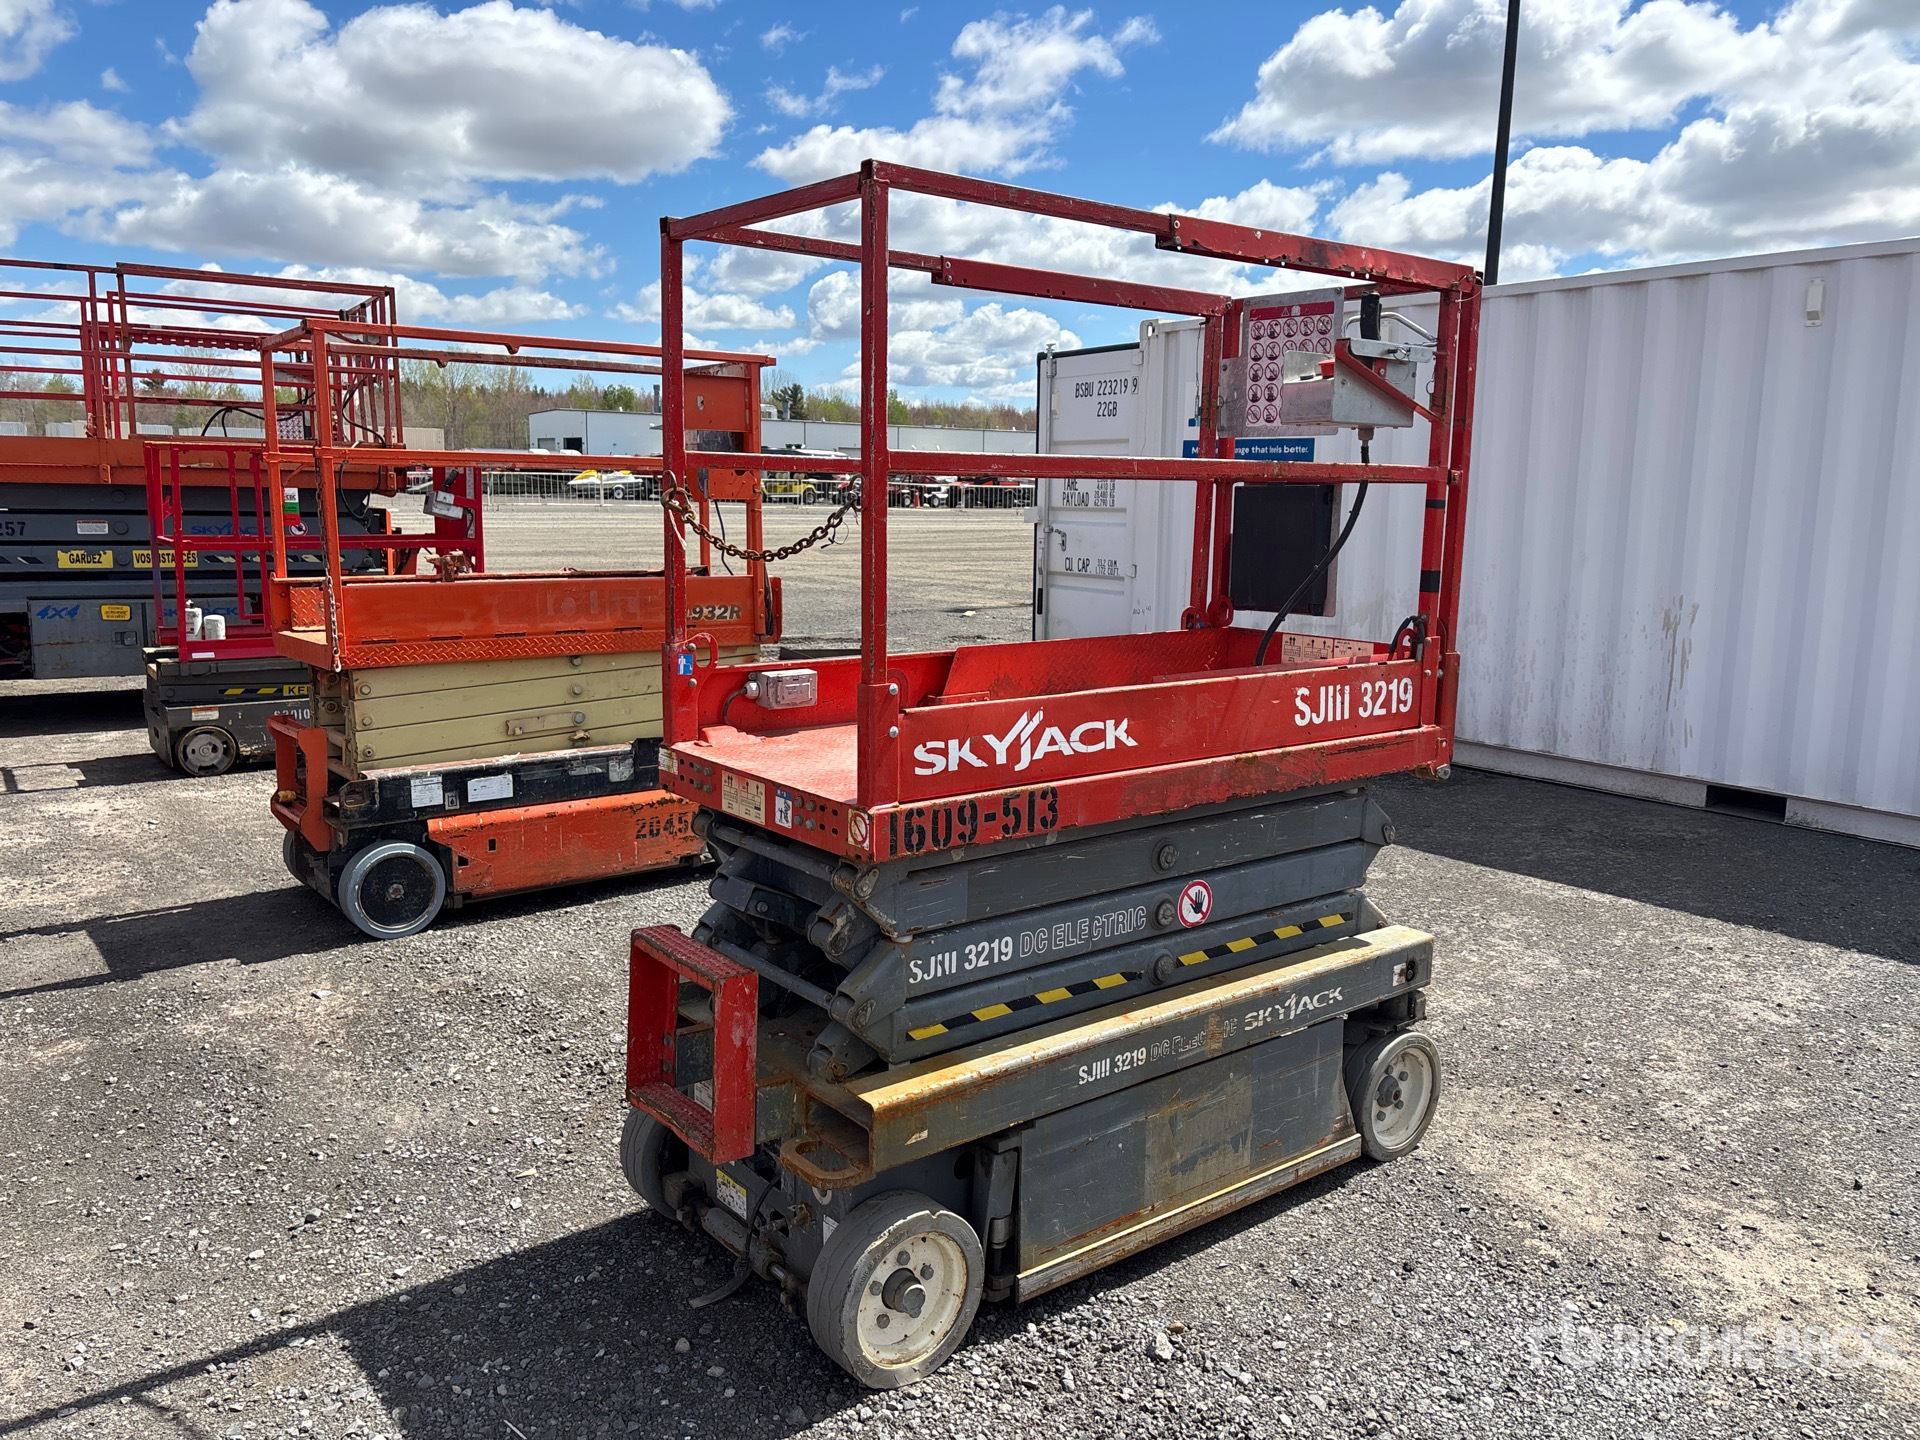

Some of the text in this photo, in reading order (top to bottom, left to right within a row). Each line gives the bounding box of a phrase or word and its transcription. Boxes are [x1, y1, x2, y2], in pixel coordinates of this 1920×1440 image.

[1075, 381, 1094, 398] BSBU
[1097, 378, 1129, 396] 223219
[1097, 401, 1118, 417] 22GB
[1251, 445, 1268, 454] that
[1063, 478, 1078, 491] TARE
[1062, 491, 1090, 507] PAYLOAD
[68, 552, 103, 565] GARDEZ
[134, 552, 151, 564] VOS
[163, 607, 238, 617] SKACK
[1294, 677, 1413, 727] SJIII 3219
[913, 707, 1139, 776] SKYJACK
[889, 786, 1059, 857] 1609-513
[964, 936, 1014, 970] 3219
[1019, 928, 1048, 957] DC
[1052, 906, 1147, 950] ELECTRIC
[1114, 1047, 1147, 1074] 3219
[1244, 986, 1343, 1031] SKYJACK
